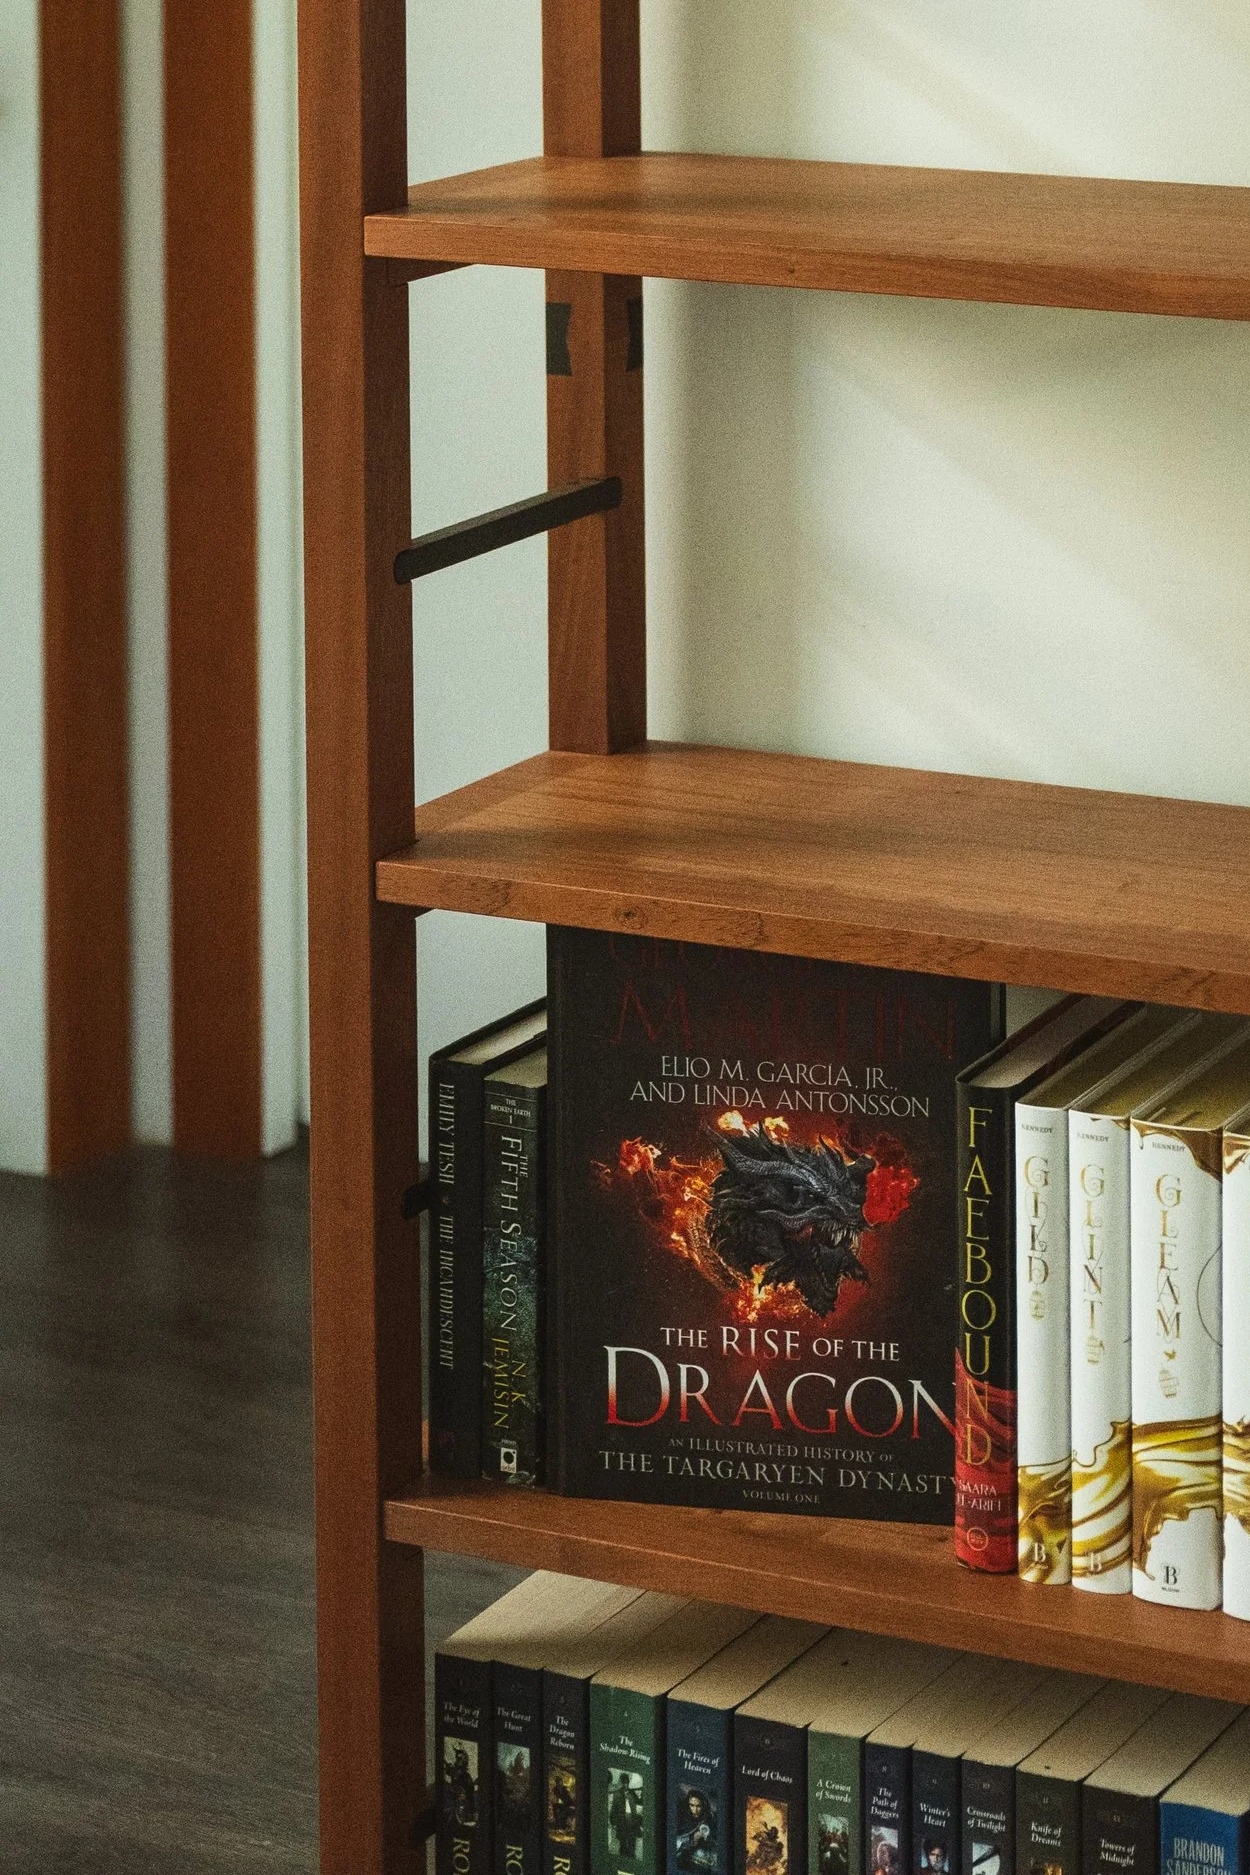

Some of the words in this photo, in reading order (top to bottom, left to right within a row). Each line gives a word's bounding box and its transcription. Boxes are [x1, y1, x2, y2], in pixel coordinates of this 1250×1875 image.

[661, 1056, 711, 1080] ELIO
[719, 1059, 749, 1082] M.
[439, 1083, 454, 1136] EMILY
[629, 1081, 685, 1104] AND
[694, 1084, 766, 1110] LINDA
[776, 1089, 930, 1119] ANTONSSON
[439, 1142, 454, 1184] TESH
[501, 1136, 522, 1211] FIFTH
[1024, 1155, 1050, 1285] GILD
[1080, 1164, 1105, 1329] GLINT
[1155, 1173, 1181, 1340] GLEAM
[500, 1220, 522, 1331] SEASON
[961, 1106, 996, 1466] FAEBOUND
[660, 1327, 708, 1348] THE
[720, 1326, 800, 1361] RISE
[812, 1337, 844, 1358] OF
[851, 1340, 900, 1362] THE
[603, 1345, 956, 1439] DRAGON
[599, 1450, 654, 1474] THE
[663, 1455, 825, 1488] TARGARYEN
[550, 1725, 575, 1739] Dragon
[556, 1715, 569, 1726] The
[550, 1737, 575, 1750] Reborn
[967, 1806, 1006, 1821] Crossroads
[977, 1819, 1006, 1834] Twilight
[1031, 1822, 1052, 1836] Knife
[1054, 1827, 1062, 1838] of
[1031, 1833, 1061, 1847] Dreams
[1173, 1837, 1225, 1867] BRANDON
